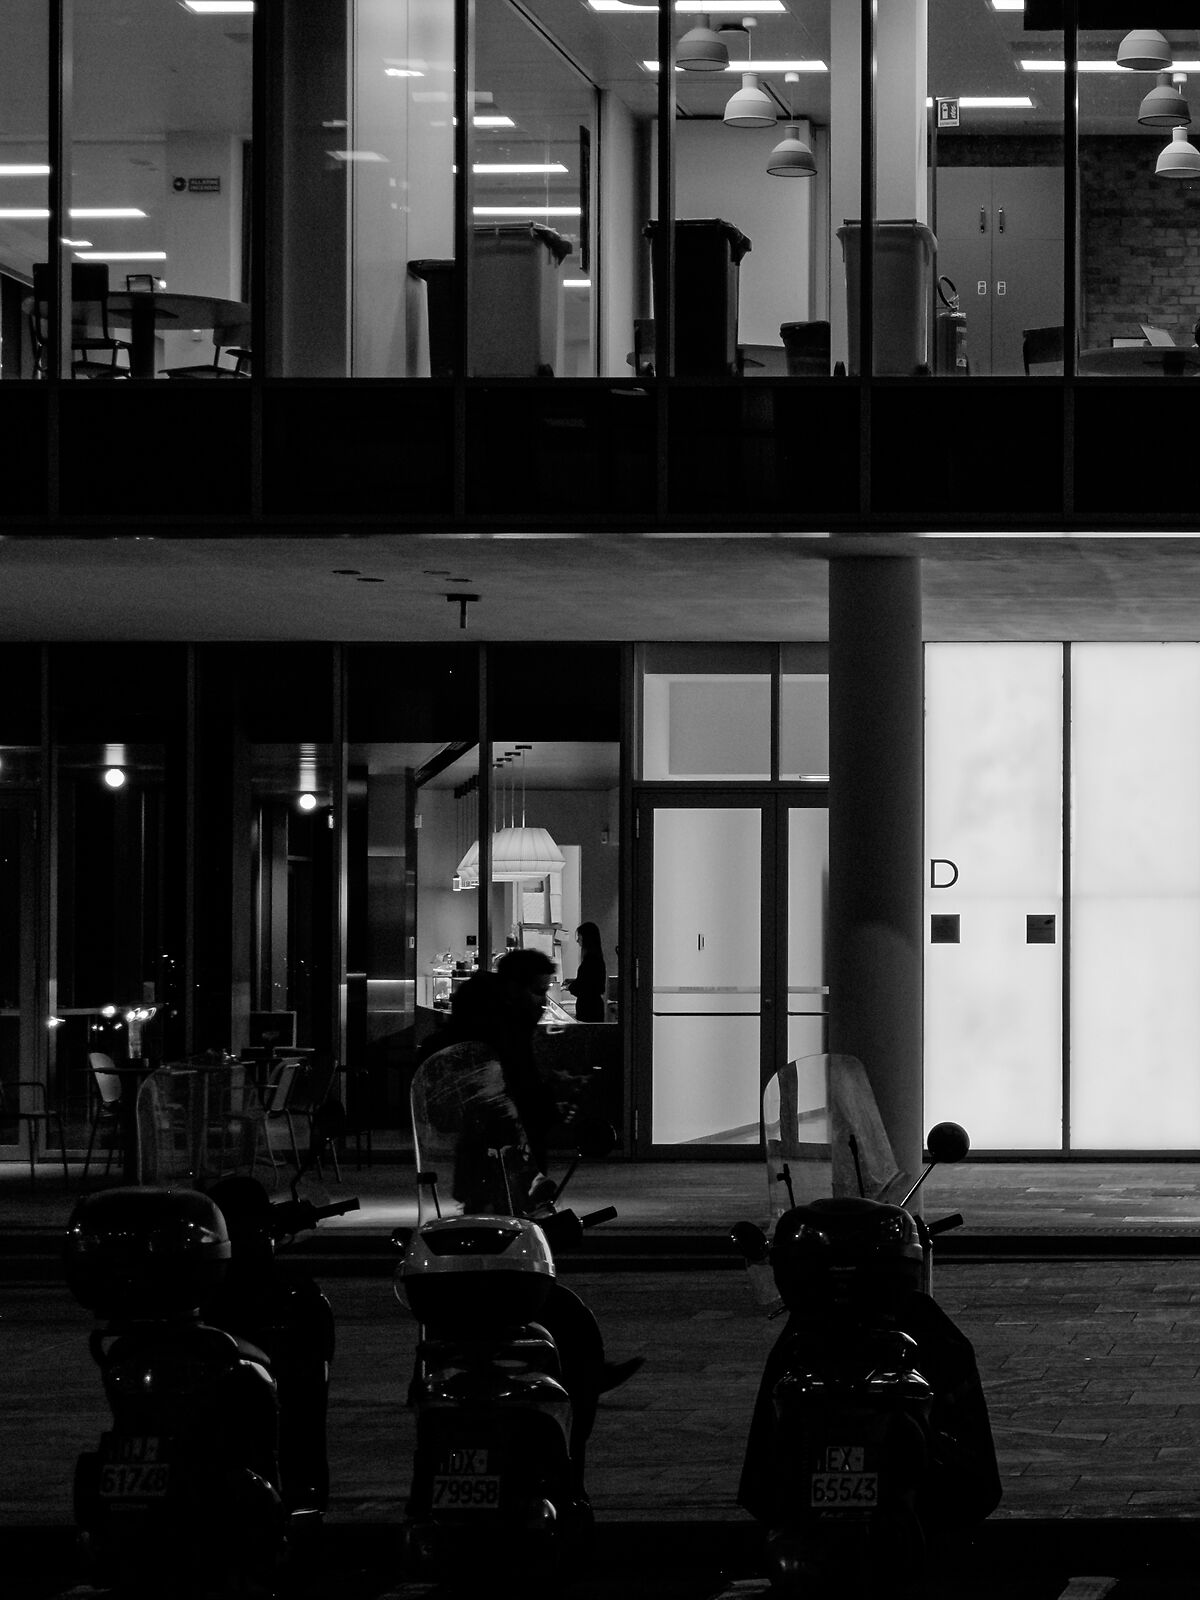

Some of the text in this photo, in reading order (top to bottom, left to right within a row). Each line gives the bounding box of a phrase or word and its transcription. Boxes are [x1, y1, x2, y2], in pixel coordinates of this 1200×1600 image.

[931, 859, 958, 888] D
[828, 1447, 852, 1471] EX
[813, 1478, 876, 1501] 65543
